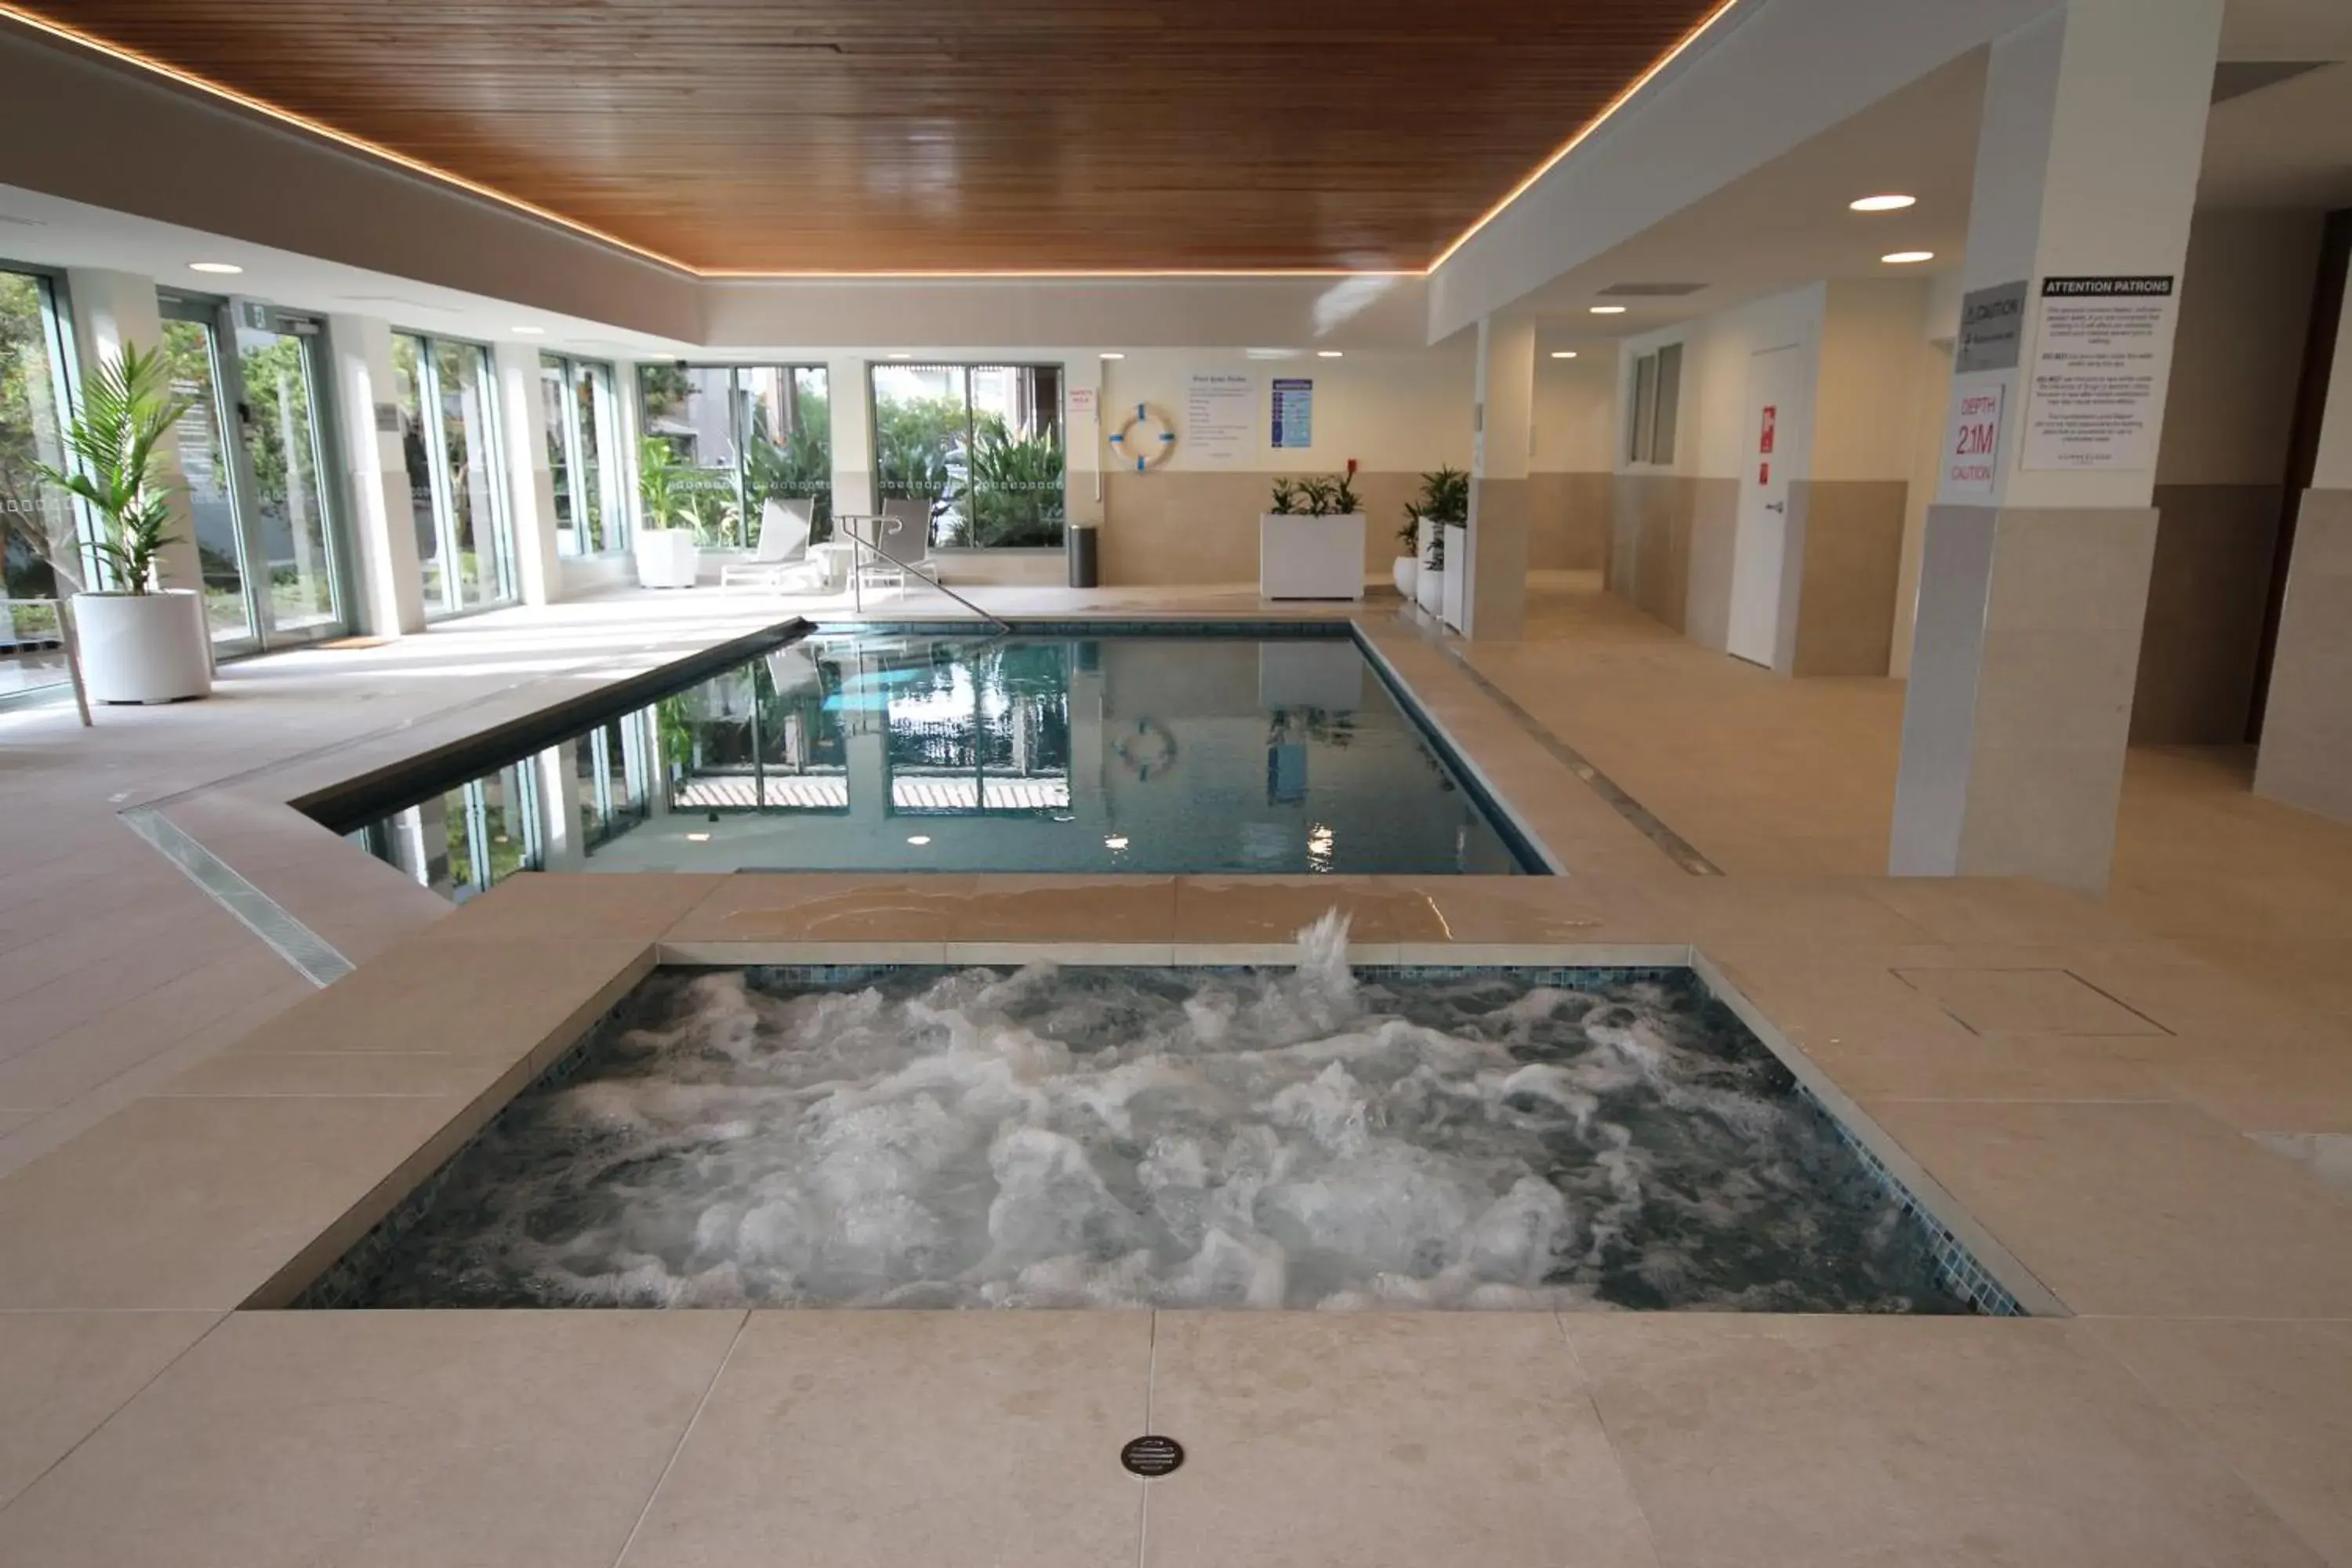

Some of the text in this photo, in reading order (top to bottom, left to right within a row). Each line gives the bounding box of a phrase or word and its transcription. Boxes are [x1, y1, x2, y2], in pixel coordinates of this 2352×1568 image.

[2045, 280, 2169, 292] ATTENTION PATRONS
[1976, 299, 2020, 321] CAUTION
[1962, 397, 1995, 416] DEPTH
[1951, 466, 1991, 481] CAUTION
